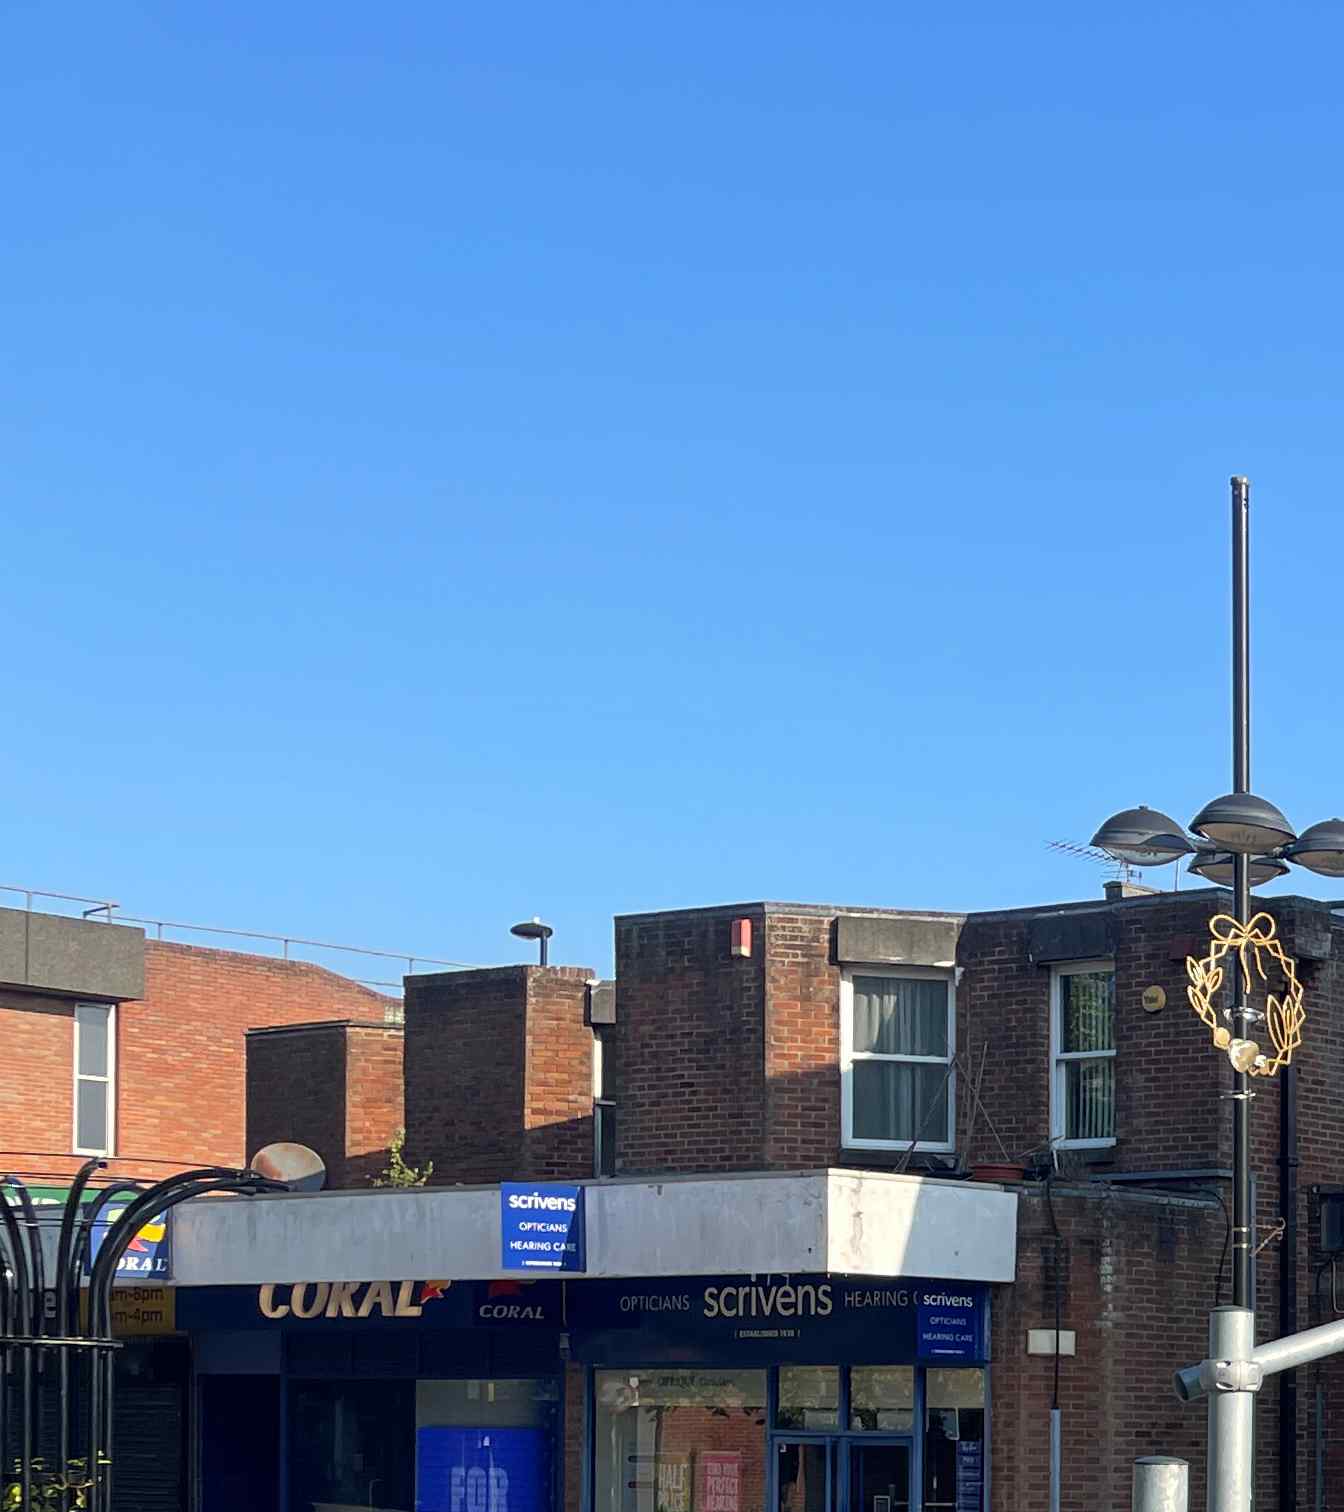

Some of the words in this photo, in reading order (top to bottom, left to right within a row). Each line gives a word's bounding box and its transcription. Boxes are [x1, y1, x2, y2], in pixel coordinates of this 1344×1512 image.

[509, 1192, 577, 1211] scrivens
[519, 1222, 568, 1233] OPTICIANS
[510, 1241, 552, 1251] HEARING
[553, 1242, 577, 1252] CARE
[116, 1257, 167, 1271] ORAL
[259, 1281, 423, 1319] CORAL
[620, 1295, 690, 1312] OPTICIANS
[703, 1278, 833, 1317] scrivens
[844, 1290, 908, 1308] HEARING
[923, 1293, 973, 1308] scrivens
[479, 1304, 545, 1320] CORAL
[929, 1316, 967, 1326] OPTICIANS
[923, 1333, 954, 1342] HEARING
